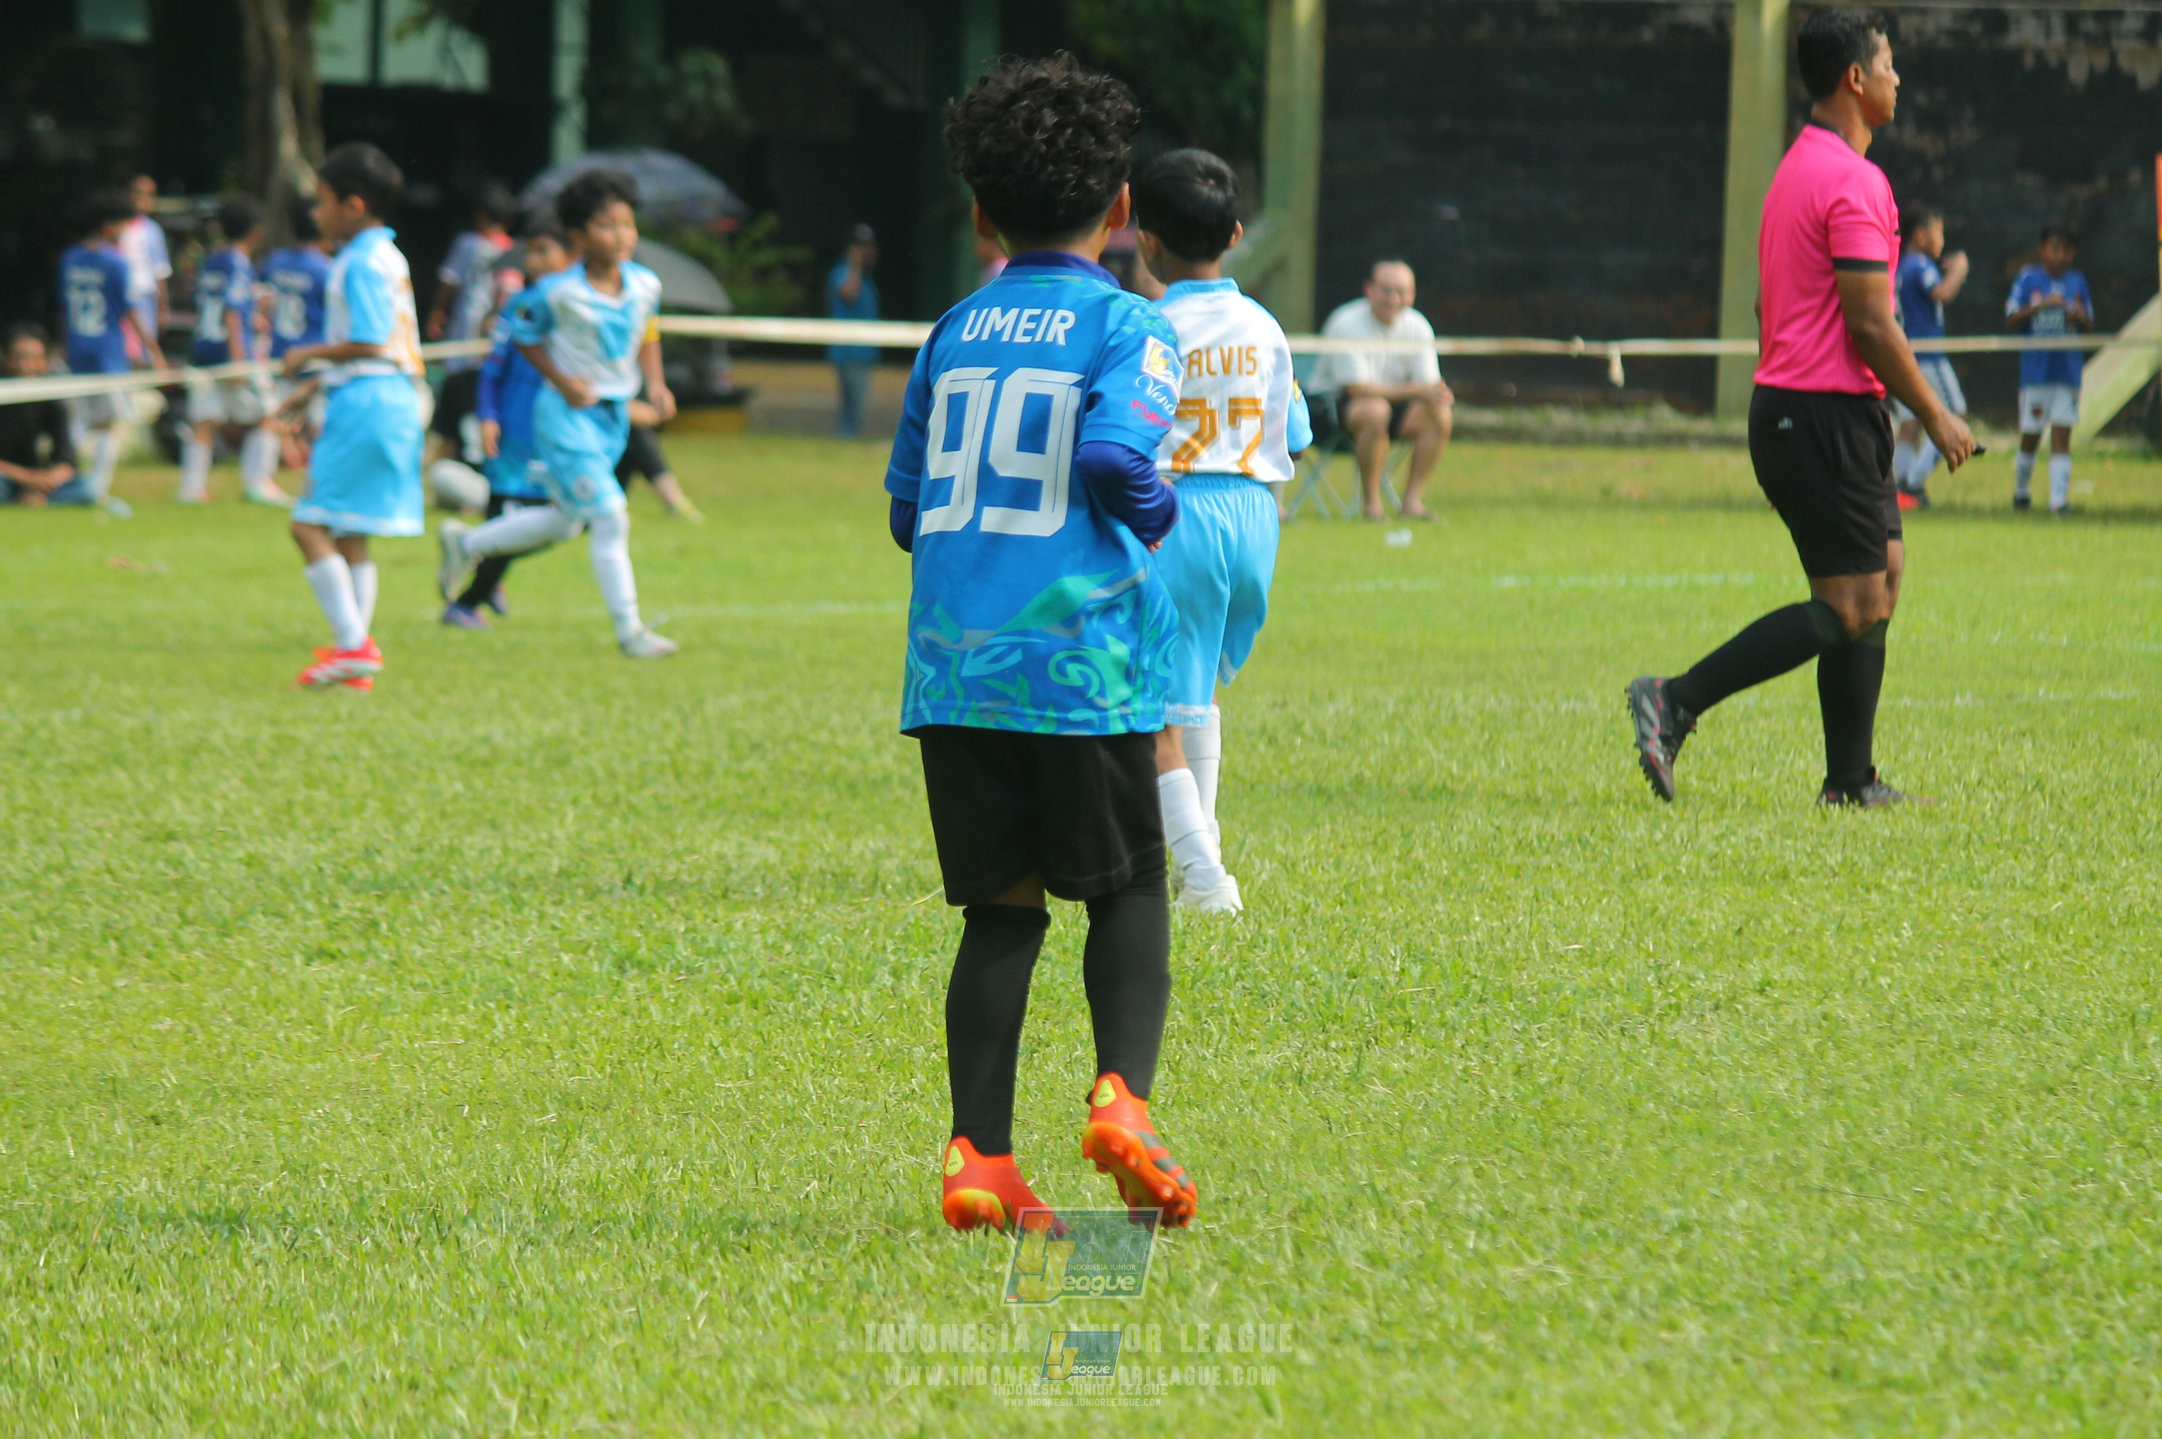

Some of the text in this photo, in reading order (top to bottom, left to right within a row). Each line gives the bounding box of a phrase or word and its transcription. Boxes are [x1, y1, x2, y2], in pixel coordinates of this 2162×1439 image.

[961, 306, 1076, 346] UMEIR
[1187, 346, 1258, 378] ALVIS
[919, 367, 1085, 538] 99
